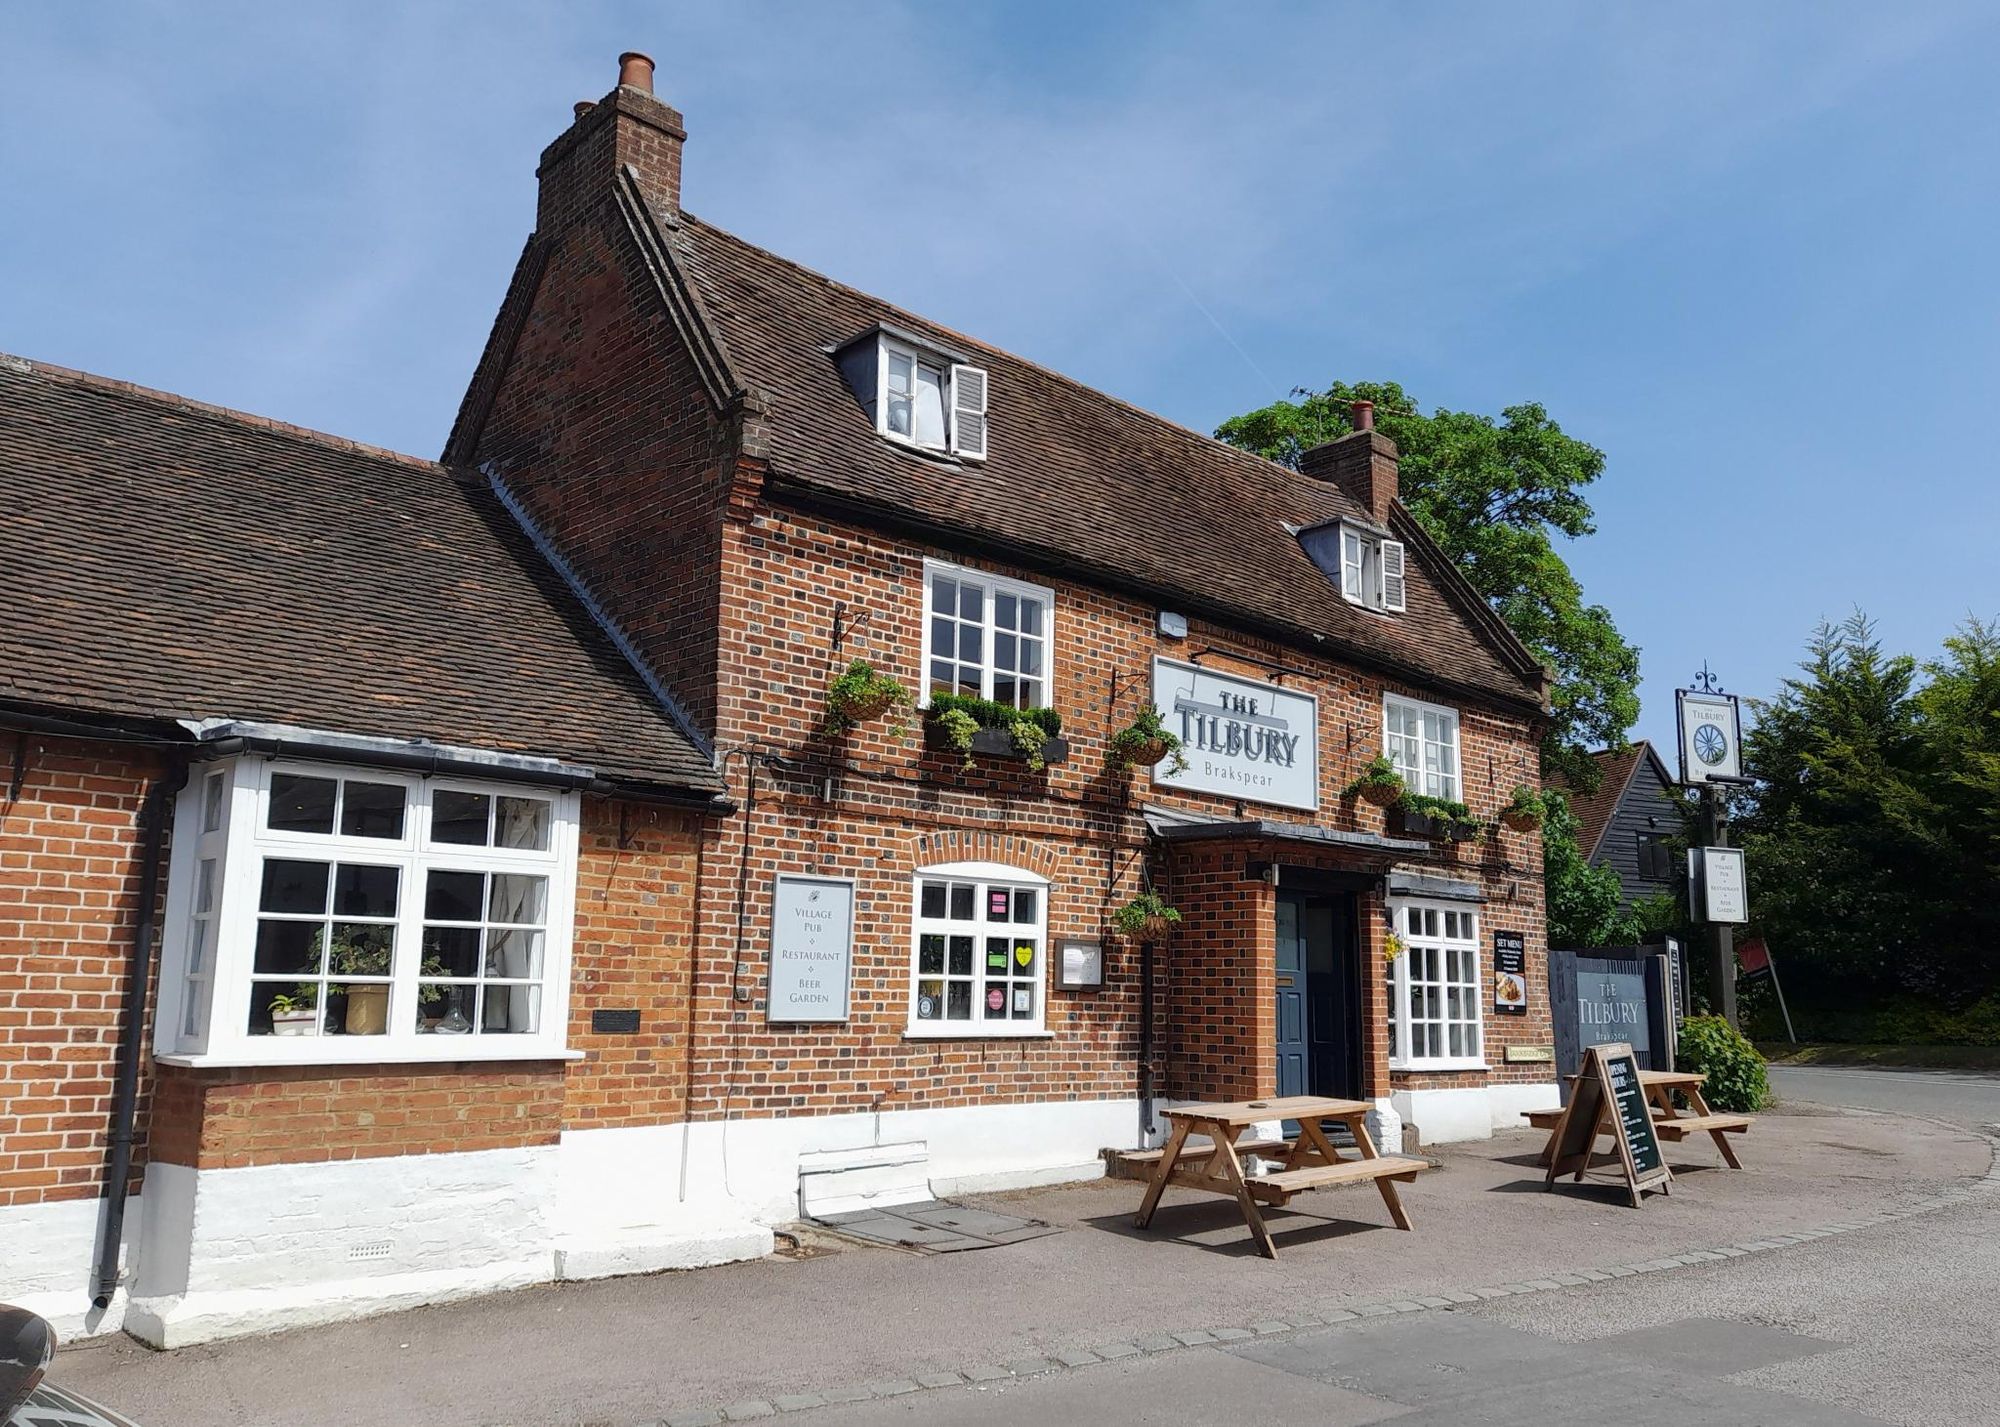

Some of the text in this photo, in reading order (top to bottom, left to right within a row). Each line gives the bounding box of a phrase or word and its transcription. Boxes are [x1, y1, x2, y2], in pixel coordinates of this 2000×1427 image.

[1219, 690, 1258, 716] THE
[1692, 710, 1725, 721] TILBURY
[1174, 703, 1299, 768] TILBURY
[1205, 761, 1273, 787] Brakspear
[795, 907, 832, 919] VILLAGE
[1497, 938, 1522, 949] SET MENU
[782, 949, 840, 961] RESTAURANT
[799, 979, 821, 988] BEER
[1599, 983, 1617, 997] THE
[789, 992, 829, 1003] GARDEN
[1578, 998, 1639, 1024] TILBURY
